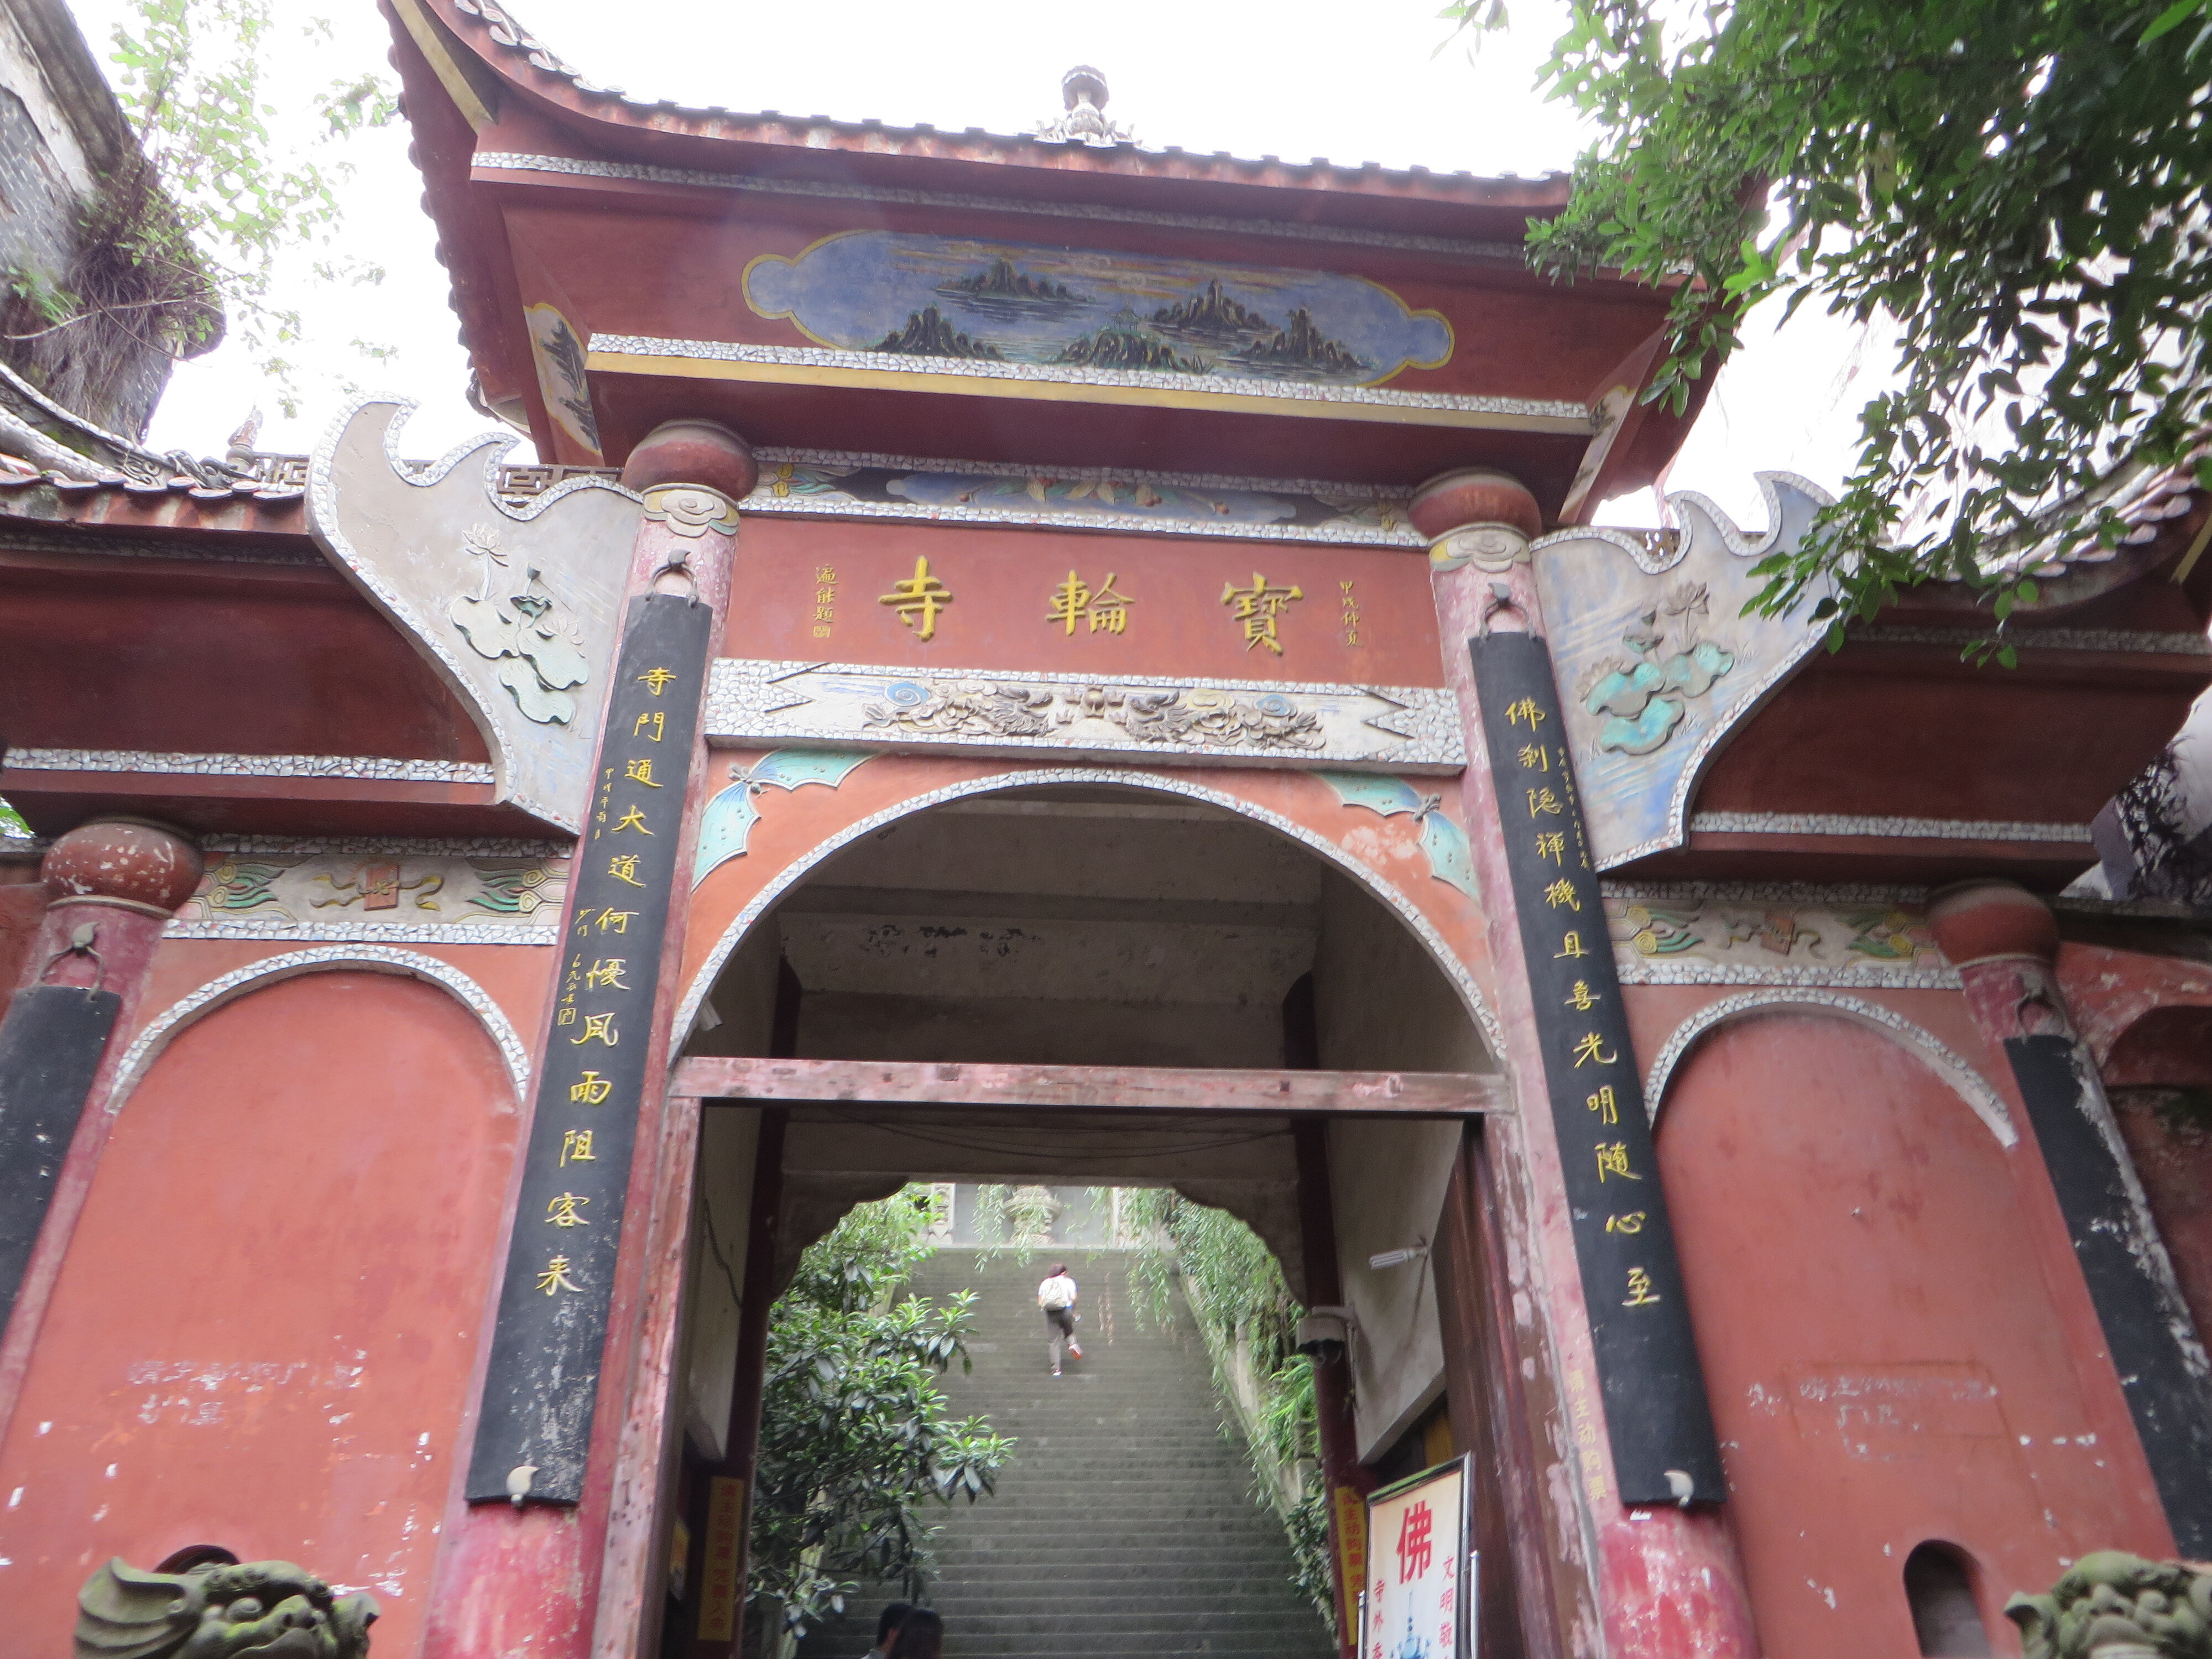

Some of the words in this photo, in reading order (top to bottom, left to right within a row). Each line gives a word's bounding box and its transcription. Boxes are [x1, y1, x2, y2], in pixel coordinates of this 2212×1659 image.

[1395, 1500, 1433, 1585] 佛
[1438, 1555, 1455, 1659] 文明敬
